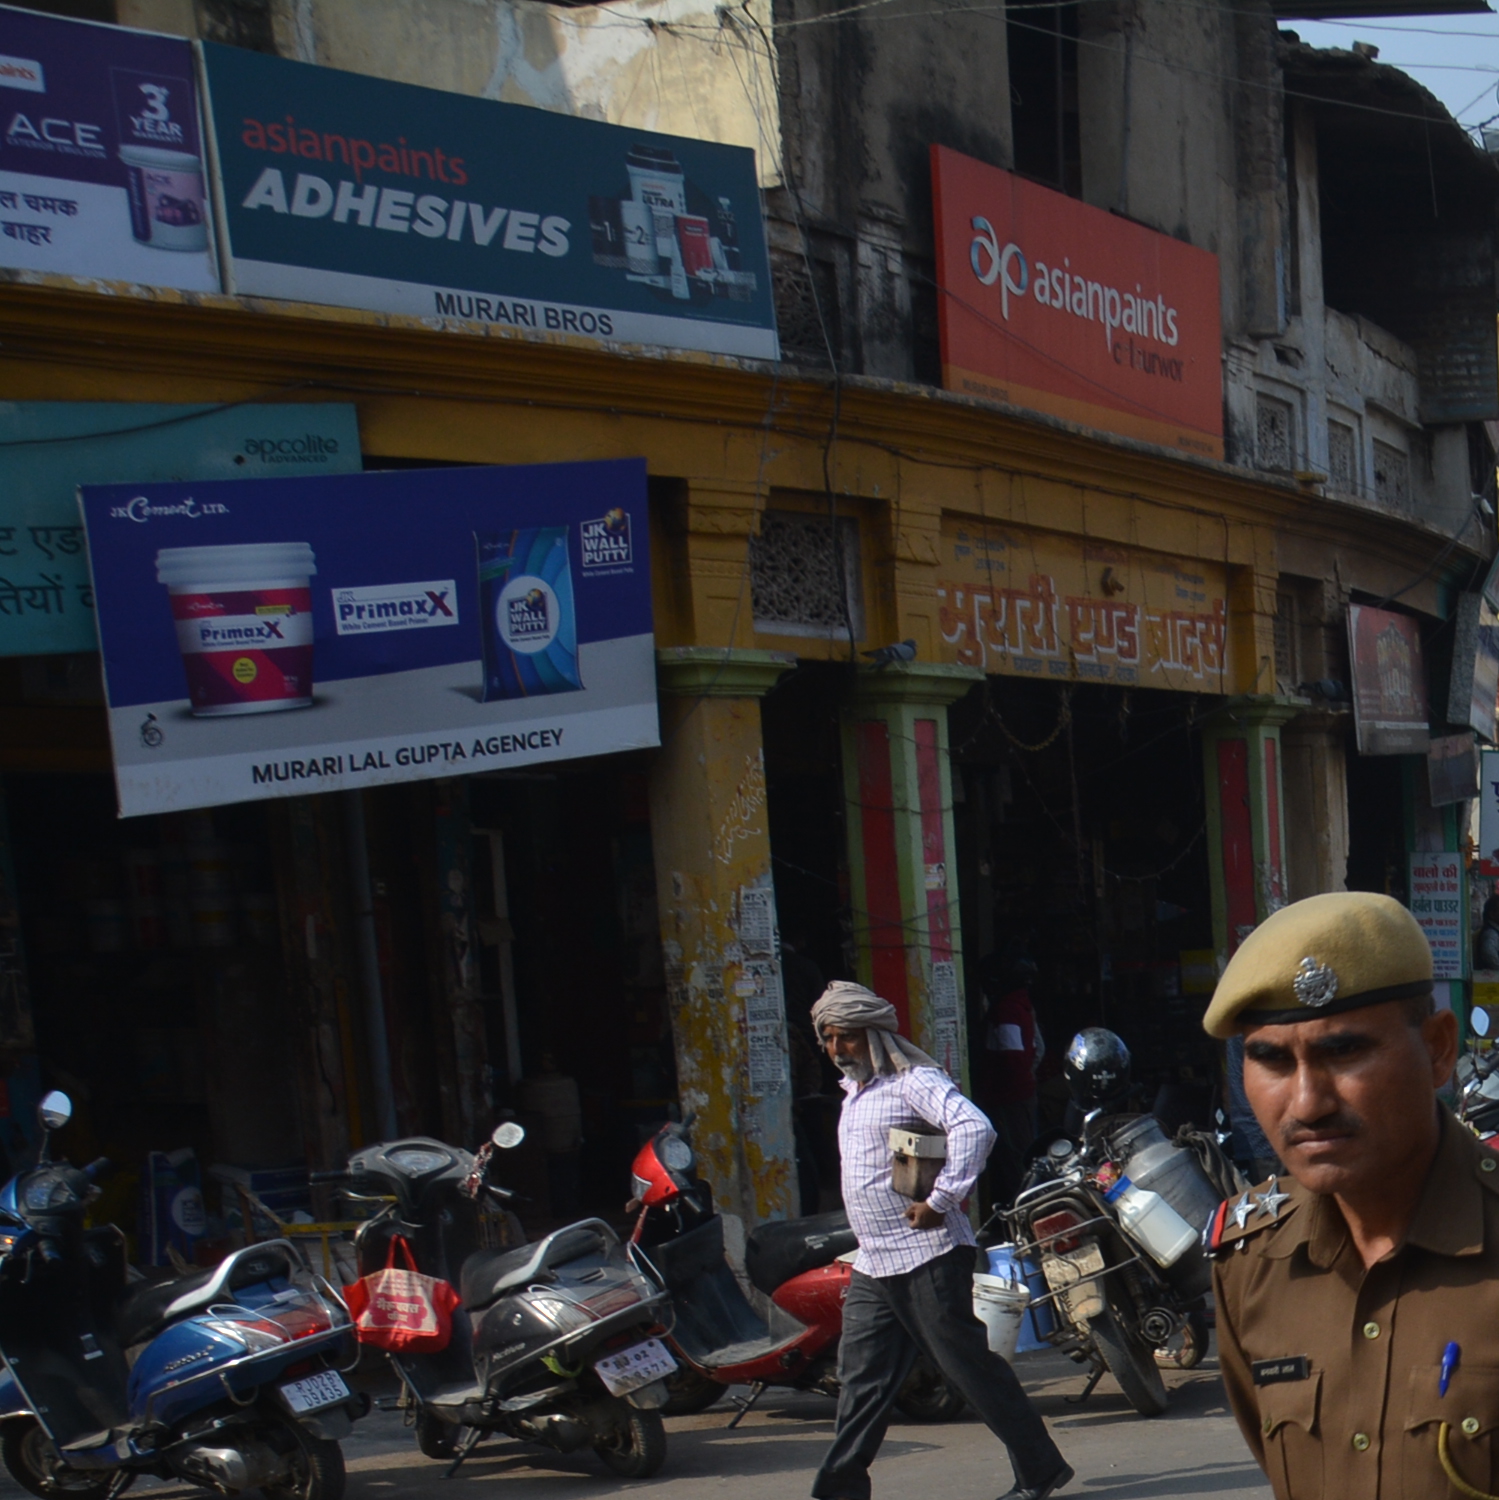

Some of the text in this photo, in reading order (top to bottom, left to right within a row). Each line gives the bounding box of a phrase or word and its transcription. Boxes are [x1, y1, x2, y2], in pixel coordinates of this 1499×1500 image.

[7, 112, 104, 150] ACE
[130, 114, 182, 138] YEAR
[241, 116, 468, 187] asianpaints
[22, 192, 78, 217] चमक
[242, 167, 572, 258] ADHESIVES
[2, 220, 52, 247] बाहर
[434, 291, 614, 338] MURARI BROS
[1032, 257, 1179, 353] asianpaints
[244, 433, 339, 466] apcolite
[268, 455, 329, 463] ADVANCED
[584, 521, 607, 539] JK
[584, 535, 628, 552] WALL
[584, 548, 628, 565] PUTTY
[511, 600, 528, 613] JK
[511, 610, 545, 623] WALL
[511, 620, 546, 633] PUTTY
[251, 727, 565, 786] MURARI LAL GUPTA AGENCEY
